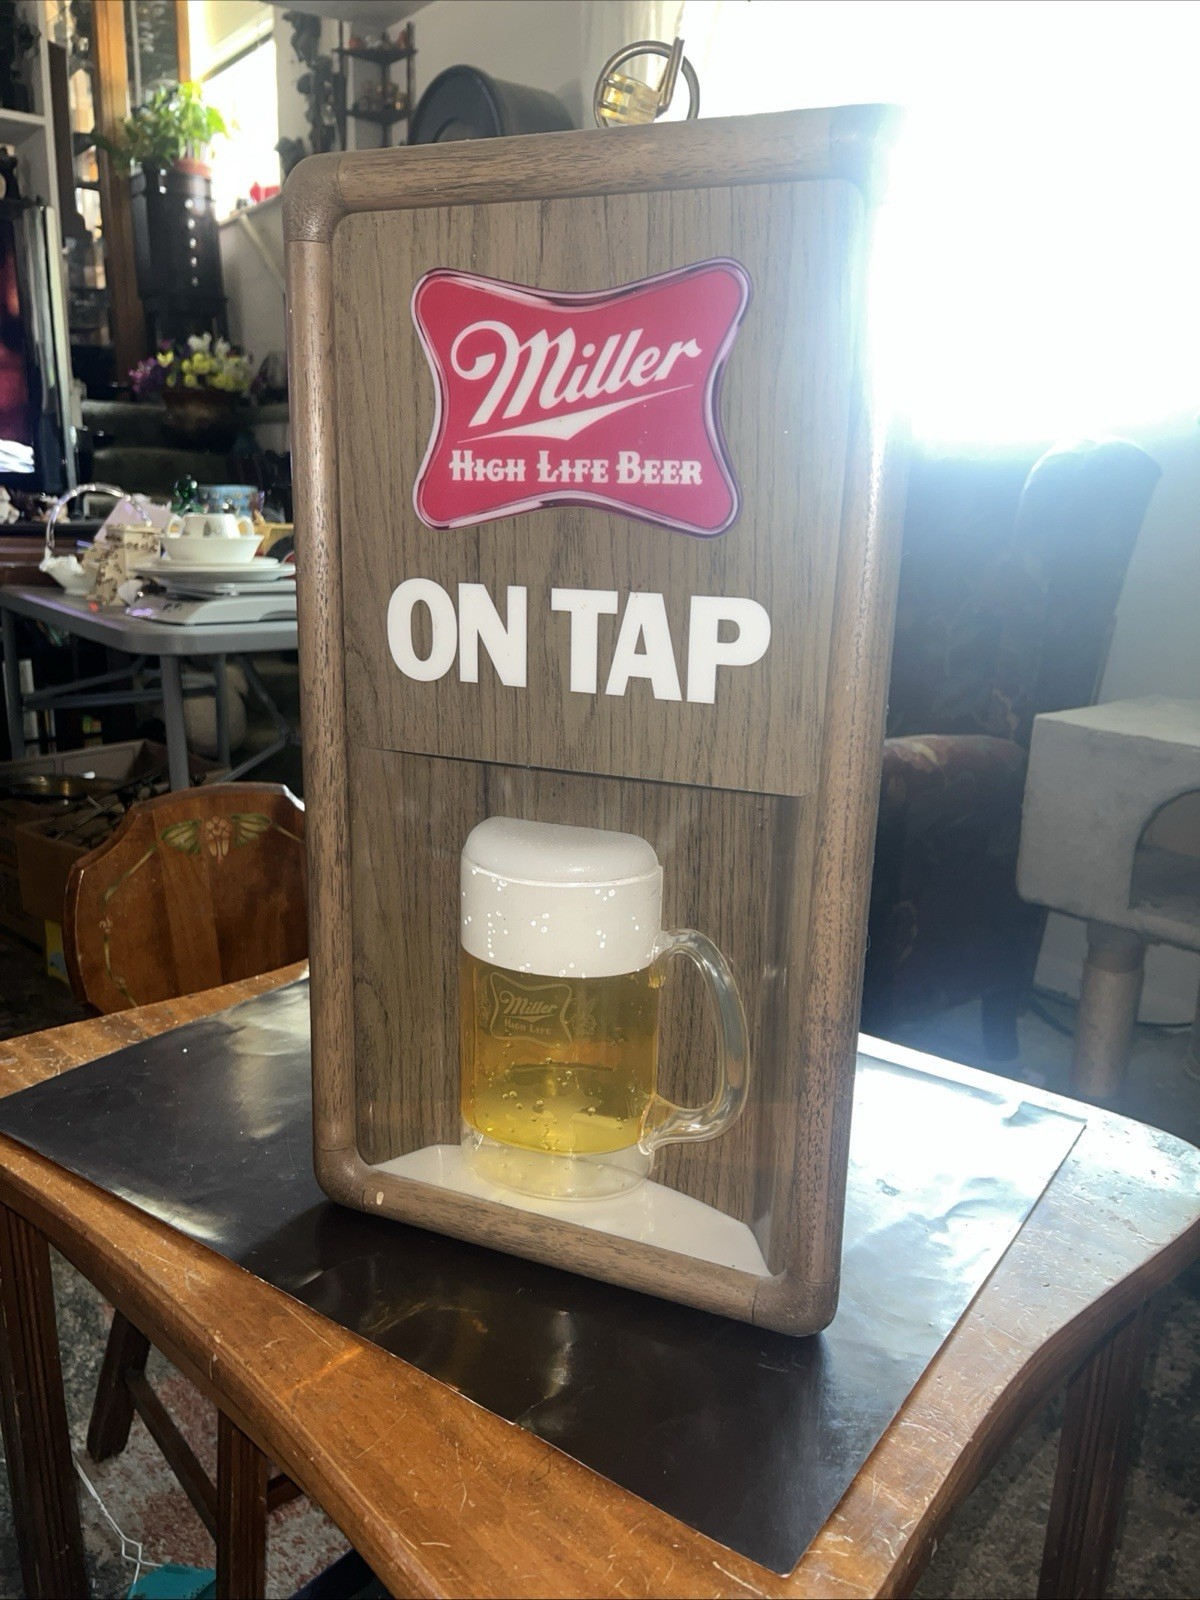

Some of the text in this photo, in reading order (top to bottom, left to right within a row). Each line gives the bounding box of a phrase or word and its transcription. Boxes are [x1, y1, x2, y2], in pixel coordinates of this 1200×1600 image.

[450, 320, 702, 428] Miller
[449, 449, 703, 486] HIGH LIFE BEER
[386, 577, 772, 705] ON TAP
[500, 990, 559, 1015] Miller
